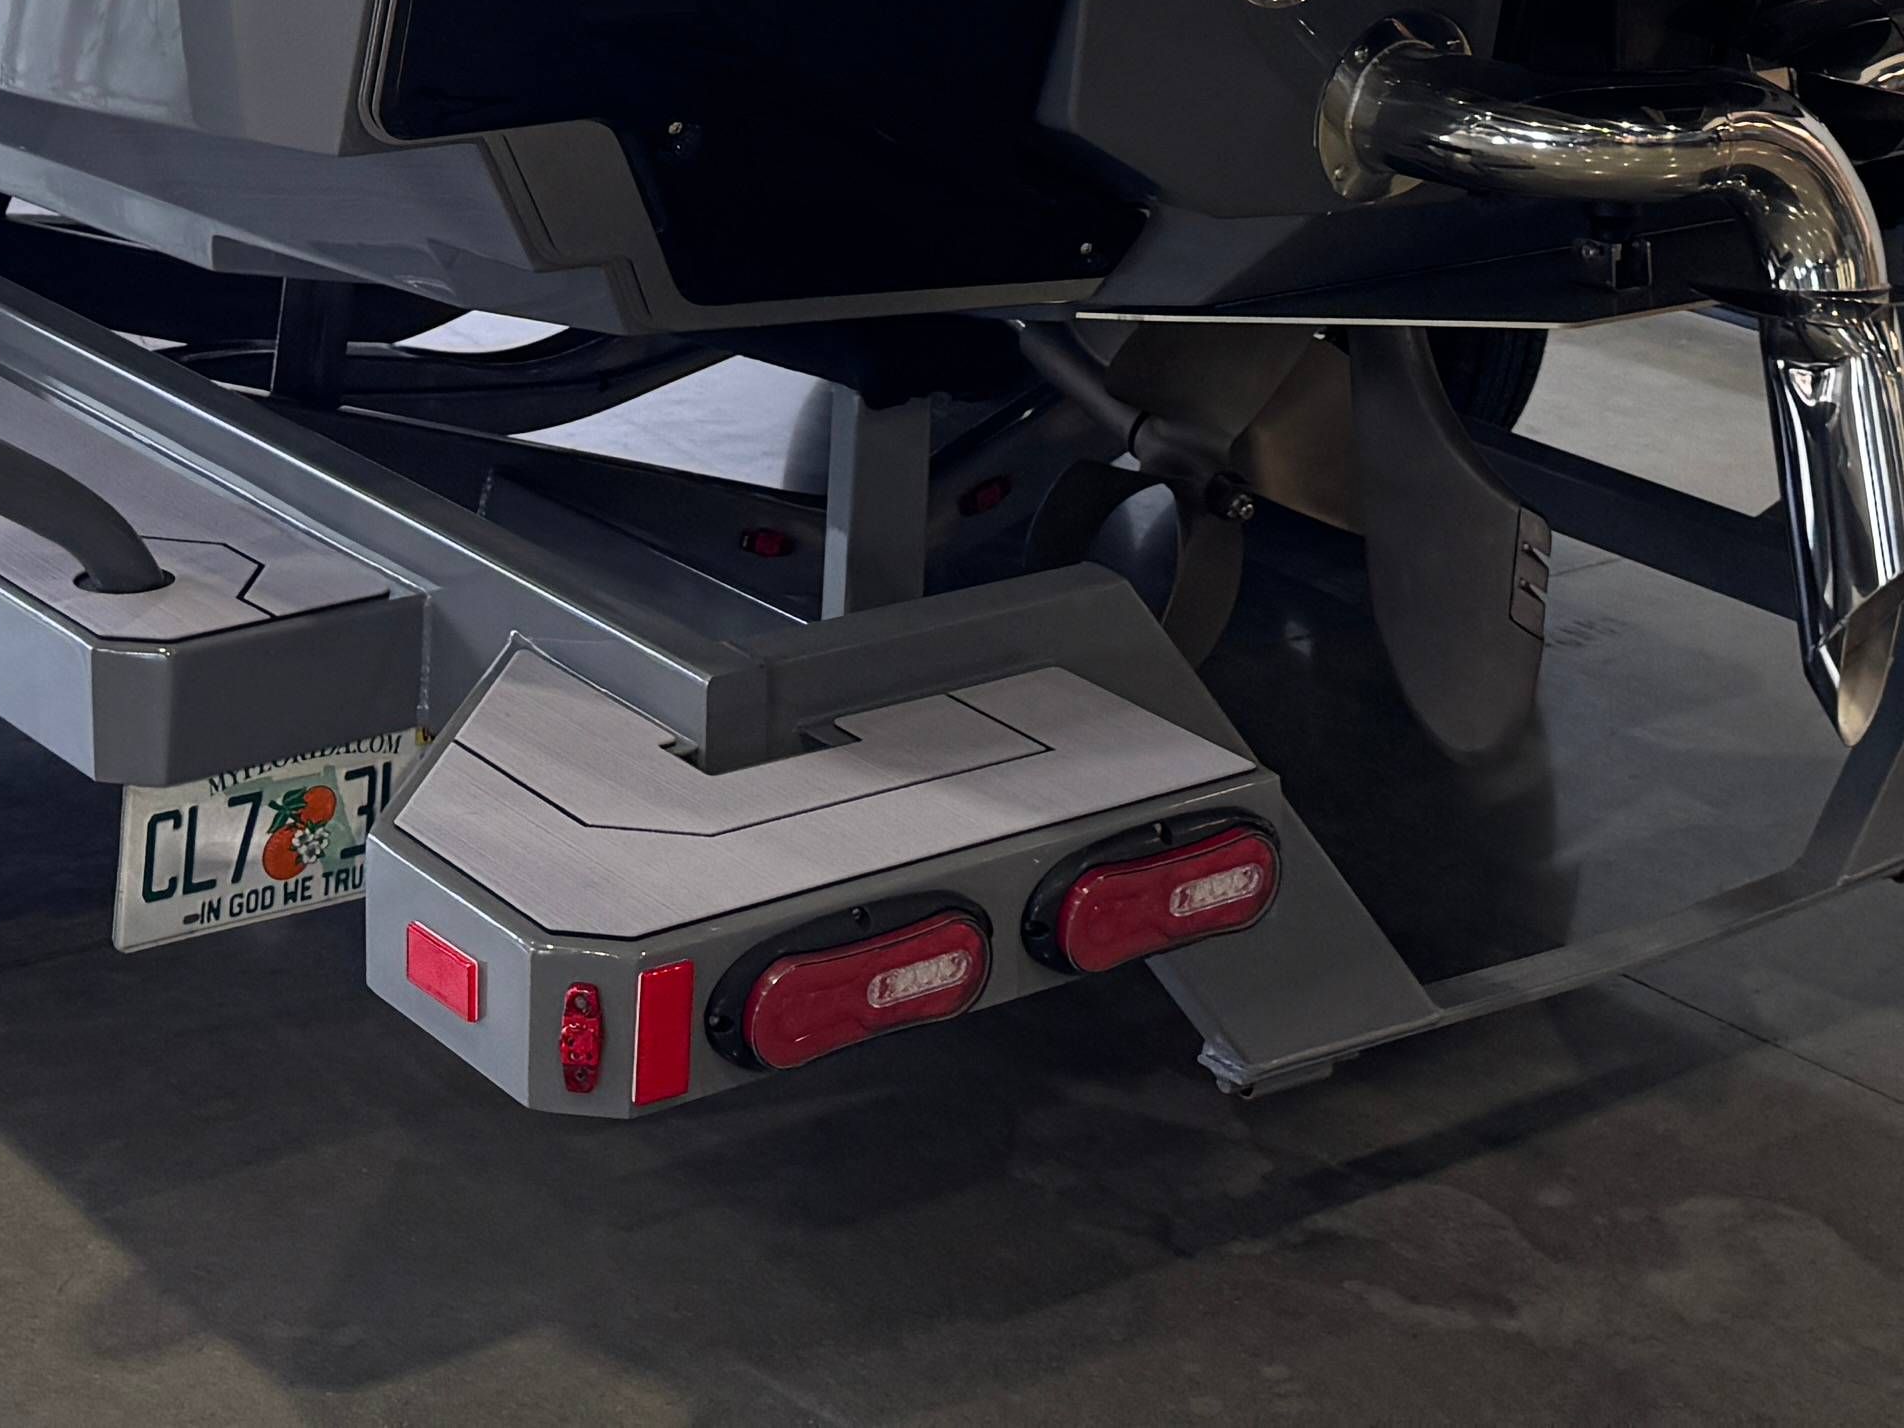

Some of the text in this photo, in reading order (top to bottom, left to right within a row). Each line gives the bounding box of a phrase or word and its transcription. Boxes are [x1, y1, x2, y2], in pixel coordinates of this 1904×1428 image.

[142, 791, 263, 903] CL7
[199, 862, 365, 925] IN GOD WE TRU
